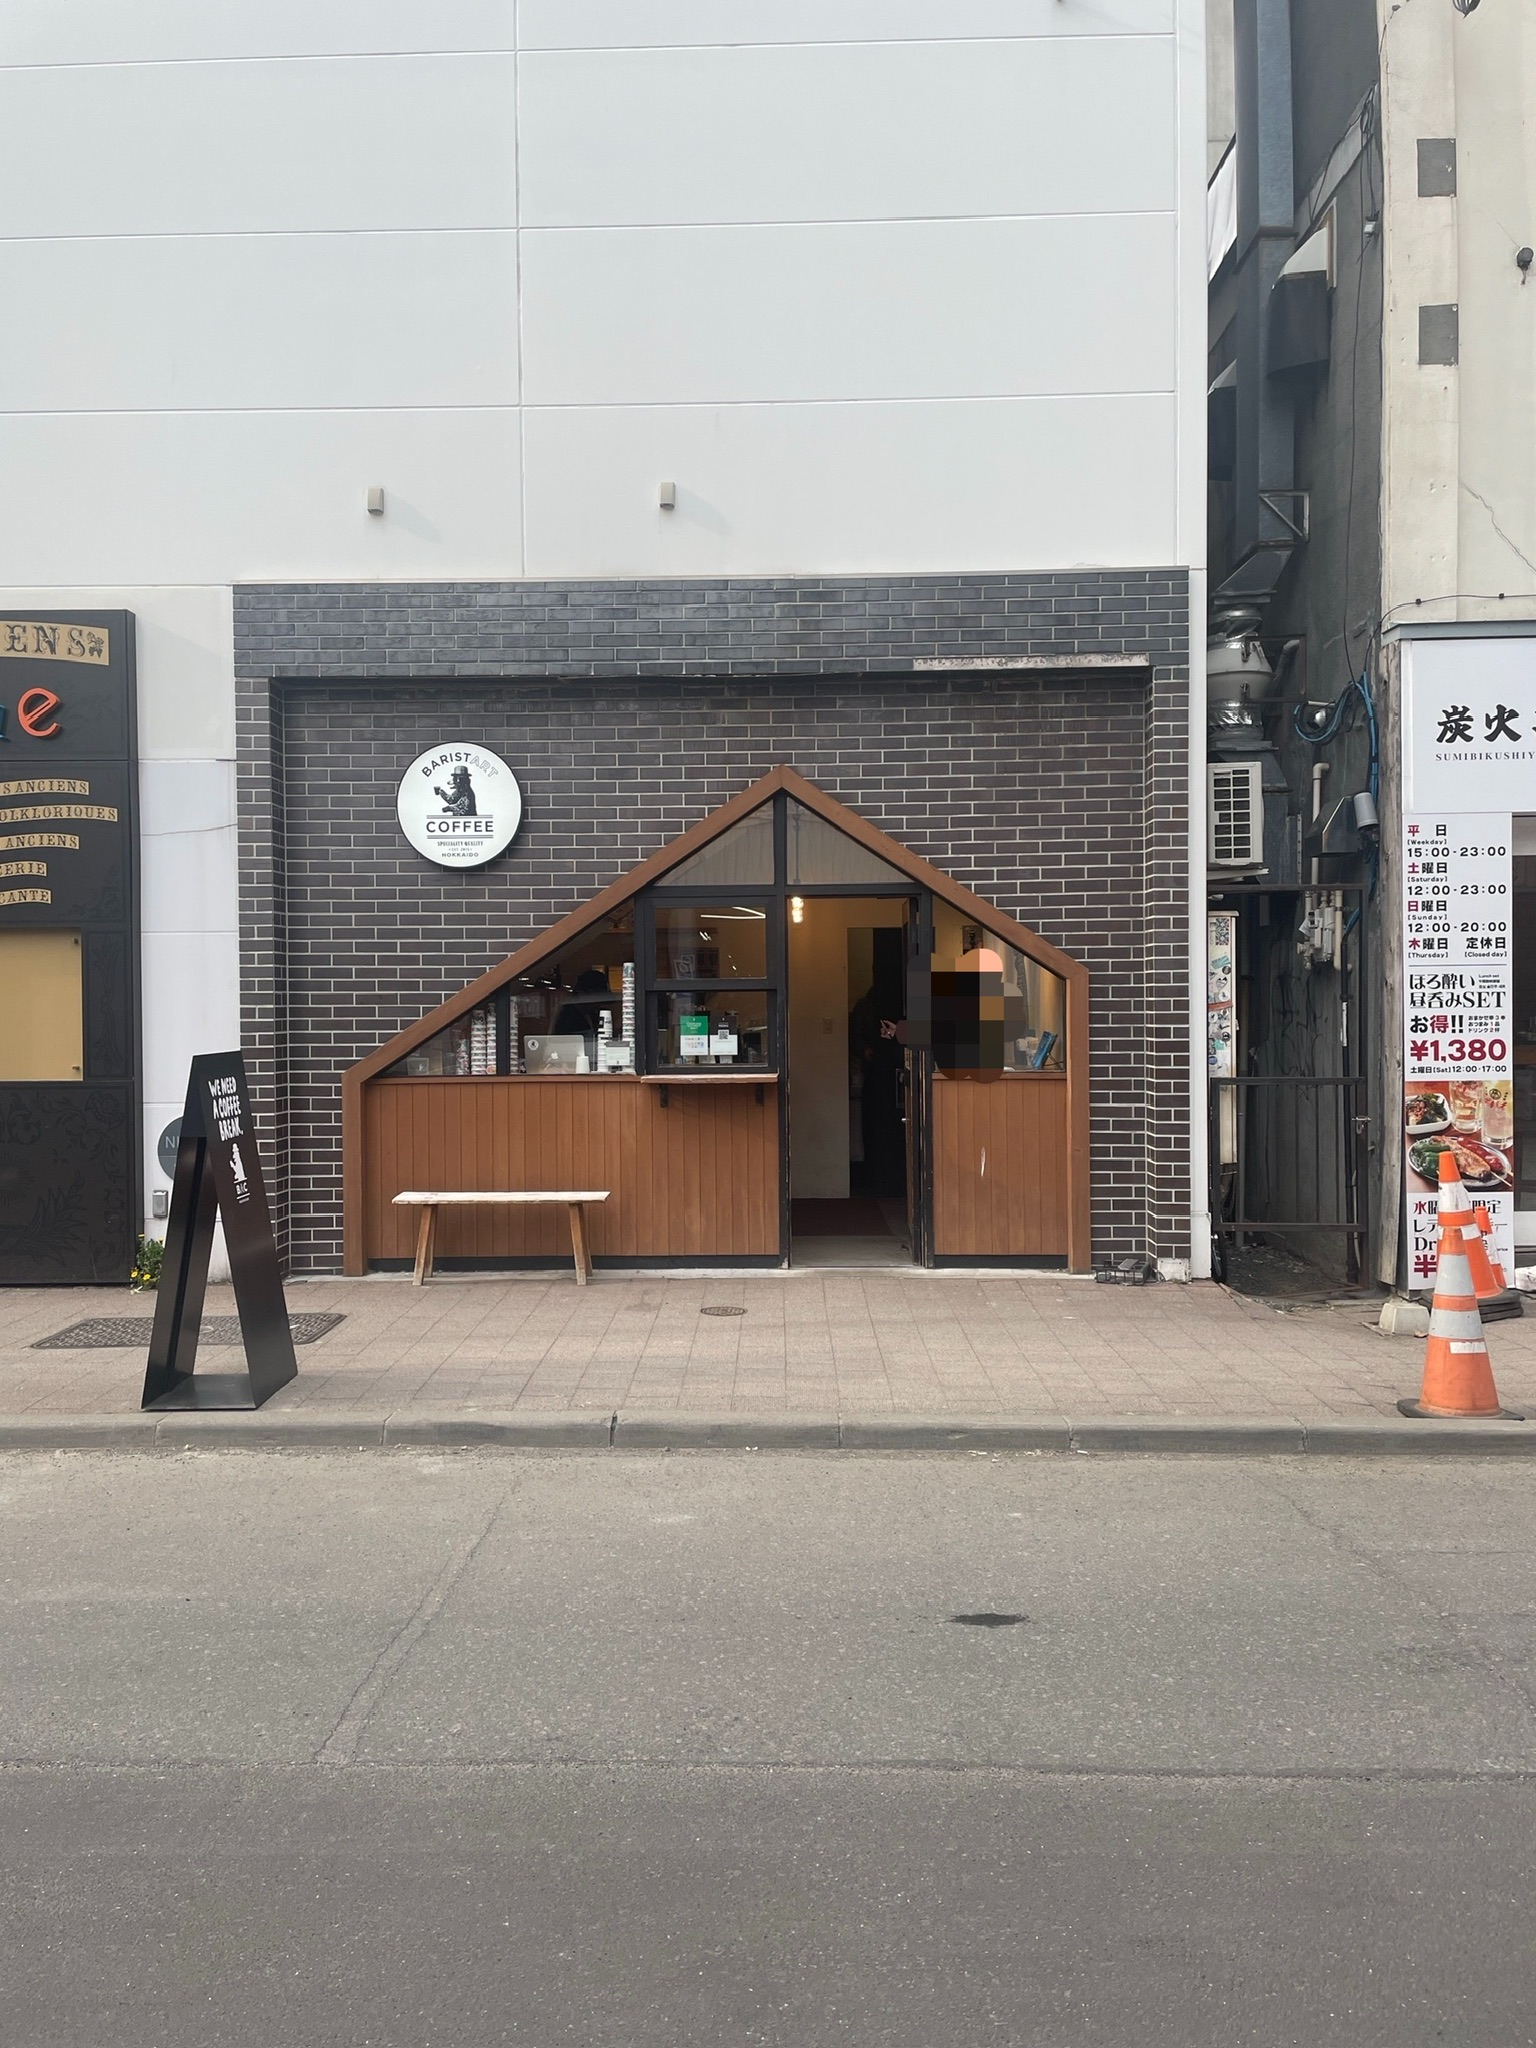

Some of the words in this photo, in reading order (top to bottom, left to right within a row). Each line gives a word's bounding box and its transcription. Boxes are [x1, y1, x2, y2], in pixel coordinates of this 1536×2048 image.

[1436, 704, 1536, 743] 炭火
[421, 752, 499, 778] BARISTART
[15, 780, 88, 794] ANCIENS
[426, 820, 494, 833] COFFEE
[5, 834, 78, 848] ANCIENS
[1408, 862, 1447, 874] 土曜日
[1408, 900, 1447, 912] 日曜日
[1408, 937, 1448, 950] 木曜日
[1466, 937, 1506, 949] 定休日
[1410, 973, 1475, 989] ほろ酔い
[1410, 1039, 1507, 1063] ¥1,380
[208, 1079, 221, 1097] WE
[221, 1076, 237, 1096] NEED
[213, 1099, 219, 1119] A
[219, 1095, 241, 1118] COFFEE
[219, 1117, 244, 1141] BREAK.
